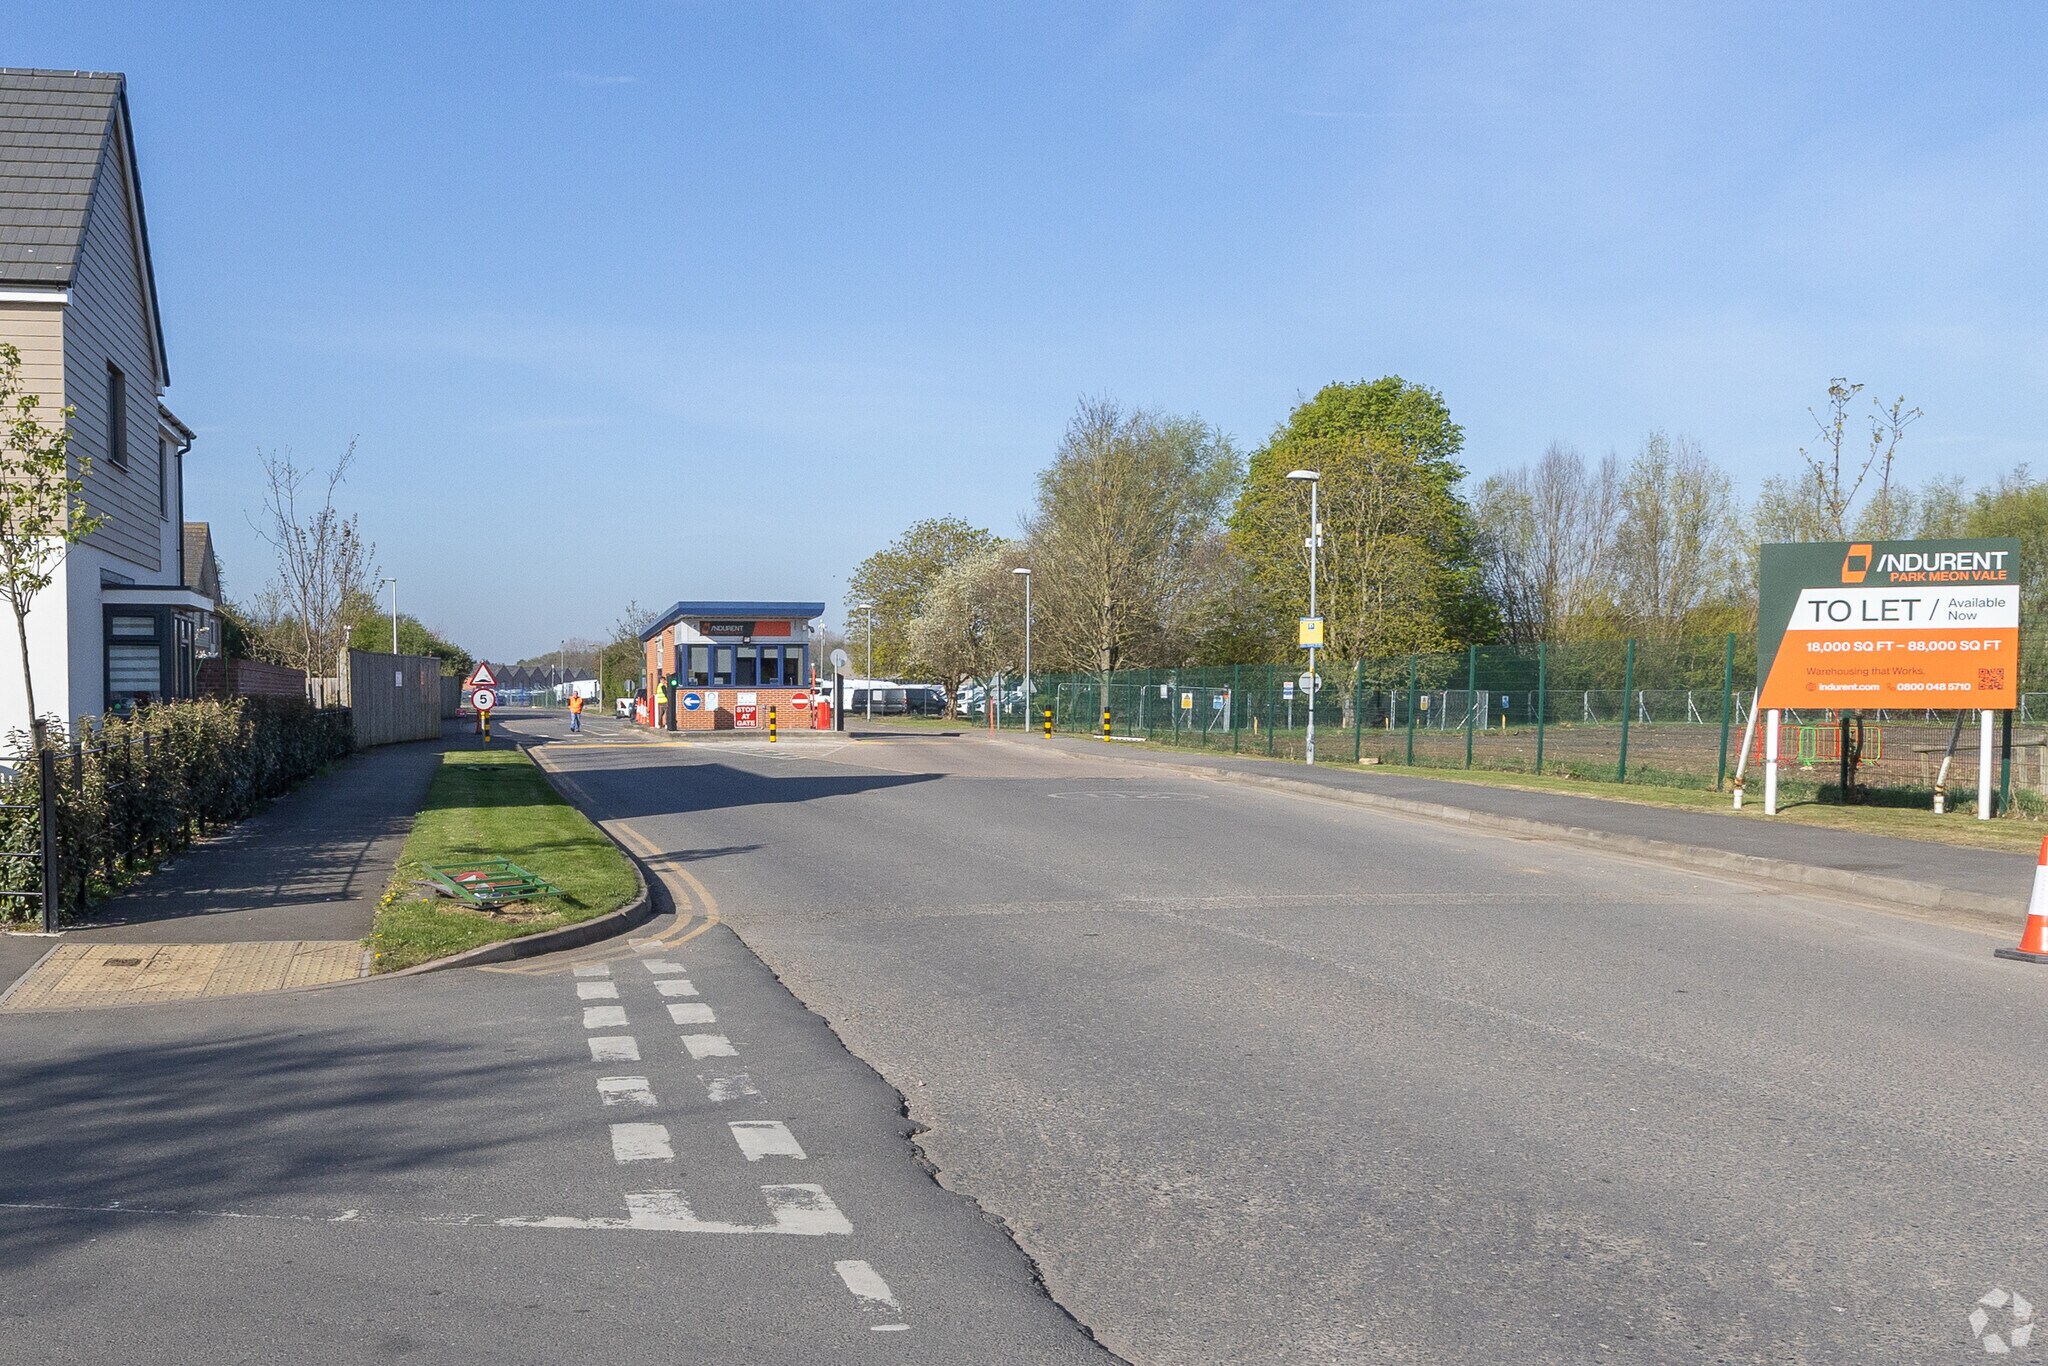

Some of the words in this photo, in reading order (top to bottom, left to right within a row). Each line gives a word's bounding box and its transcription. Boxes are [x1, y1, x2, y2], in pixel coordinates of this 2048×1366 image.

[1890, 572, 1927, 582] PARK
[1929, 572, 1969, 581] MEON
[1971, 571, 2007, 580] VALE
[1948, 598, 2005, 608] Available
[1808, 600, 1851, 622] TO
[1863, 599, 1921, 621] LET
[1948, 611, 1977, 620] Now
[1807, 642, 1850, 652] 18,000
[1853, 642, 1874, 651] SQ
[1877, 642, 1894, 651] FT
[1908, 641, 1957, 651] 88,000
[1960, 641, 1981, 651] SQ
[1984, 640, 2001, 650] FT
[1807, 667, 1869, 677] Warehousing
[1871, 667, 1890, 675] that
[1893, 667, 1925, 675] Works.
[1819, 683, 1880, 691] indurent.com
[1897, 683, 1925, 691] 0800
[1948, 683, 1971, 691] 5710
[480, 695, 487, 704] 5
